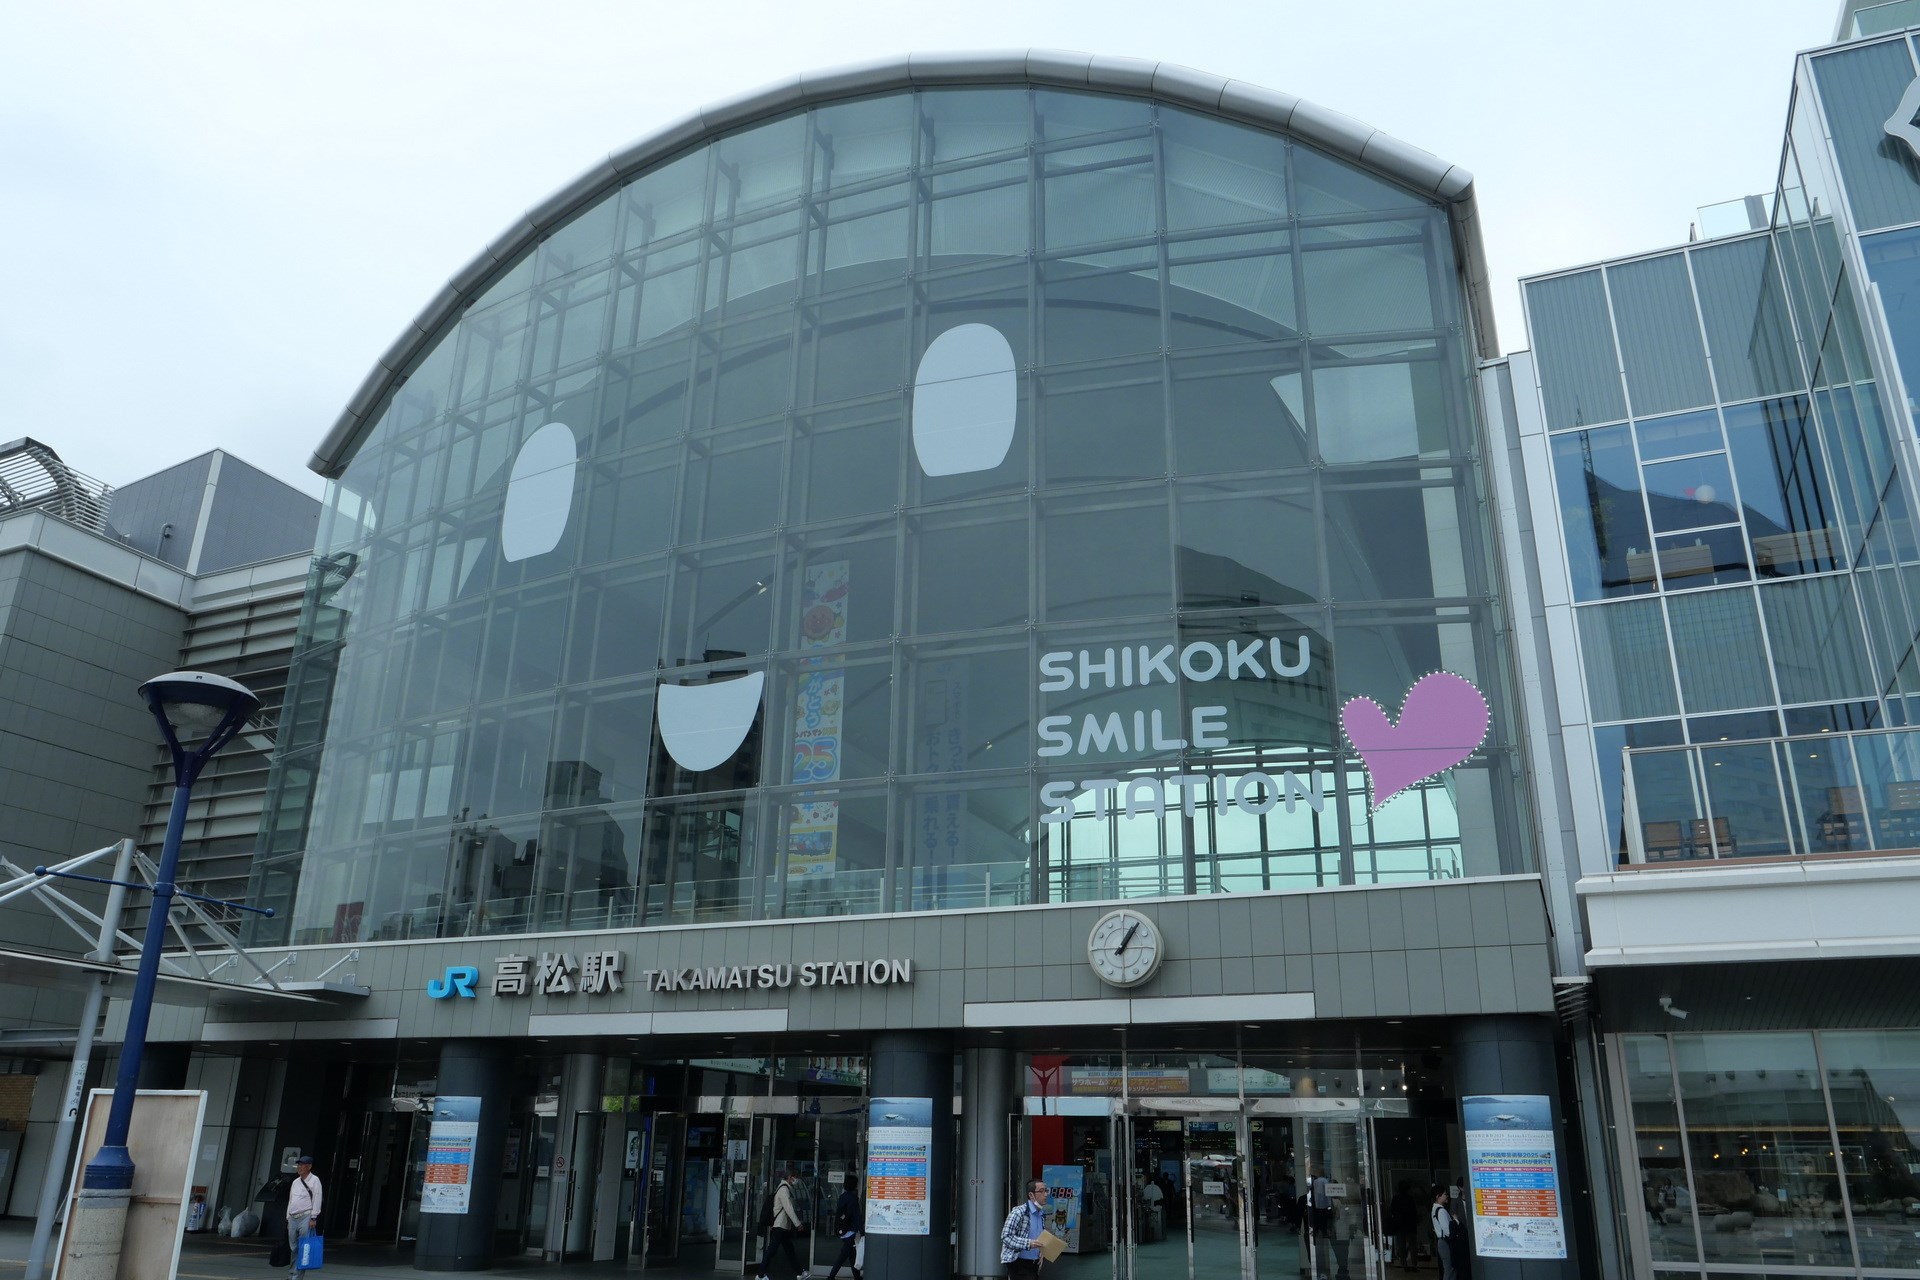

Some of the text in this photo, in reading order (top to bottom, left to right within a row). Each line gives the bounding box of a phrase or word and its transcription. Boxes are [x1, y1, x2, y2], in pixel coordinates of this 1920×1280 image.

[1039, 635, 1310, 692] SHIKOKU
[1037, 706, 1230, 757] SMILE
[793, 738, 837, 783] 25
[1039, 769, 1325, 824] STATION
[427, 951, 914, 999] JR 高松駅 TAKAMATSU STATION
